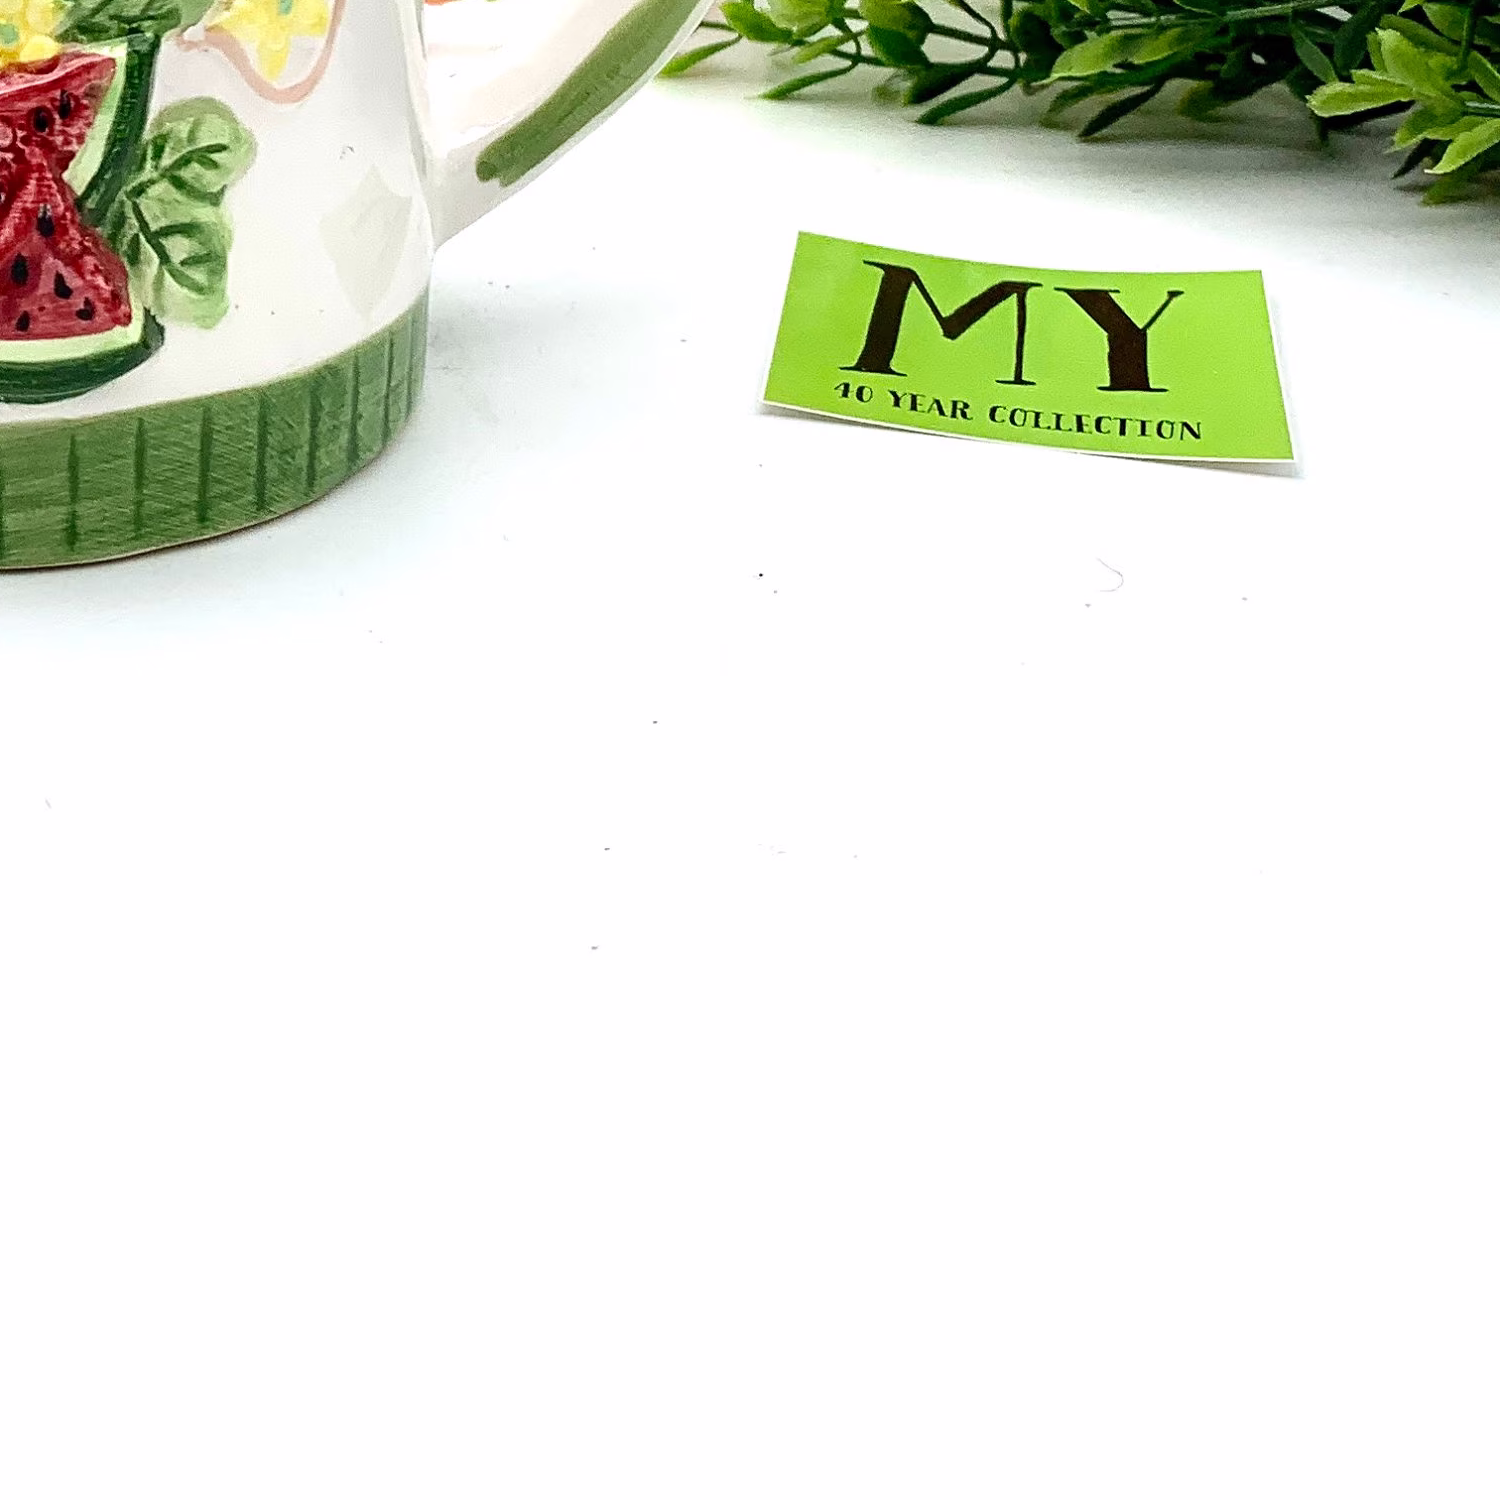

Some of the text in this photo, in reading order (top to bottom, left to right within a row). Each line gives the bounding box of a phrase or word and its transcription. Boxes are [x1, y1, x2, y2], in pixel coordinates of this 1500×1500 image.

[838, 260, 1184, 392] MY
[833, 380, 1202, 440] 40 YEAR COLLECTION
